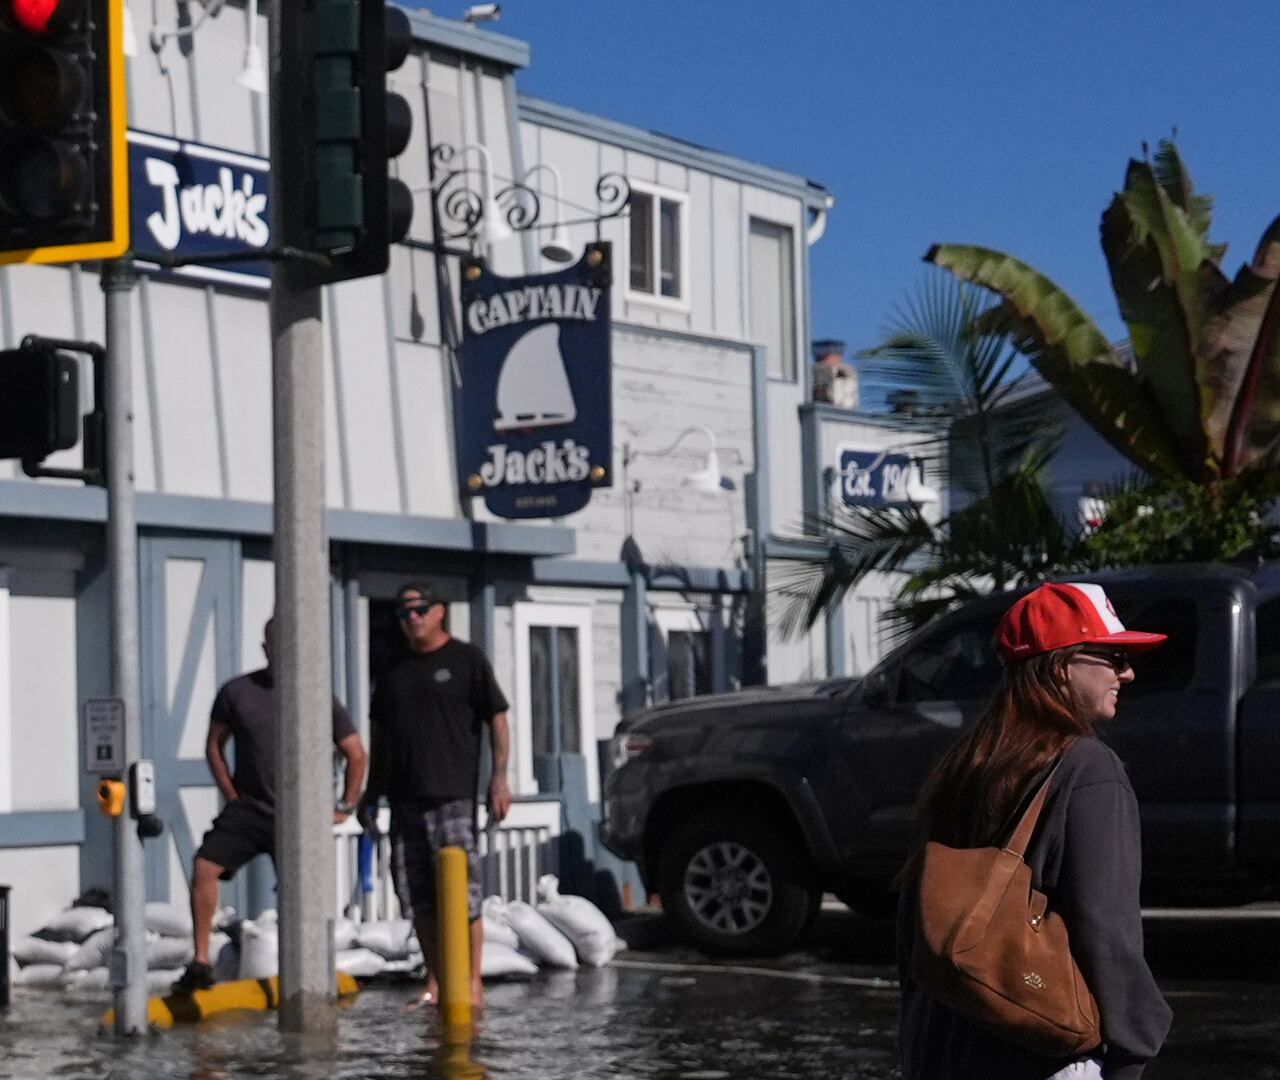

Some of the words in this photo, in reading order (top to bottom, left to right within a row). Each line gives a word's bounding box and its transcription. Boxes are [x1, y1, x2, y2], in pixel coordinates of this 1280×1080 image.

[145, 156, 270, 250] Jack's
[467, 284, 602, 336] CAPTAIN
[479, 438, 590, 487] Jack's
